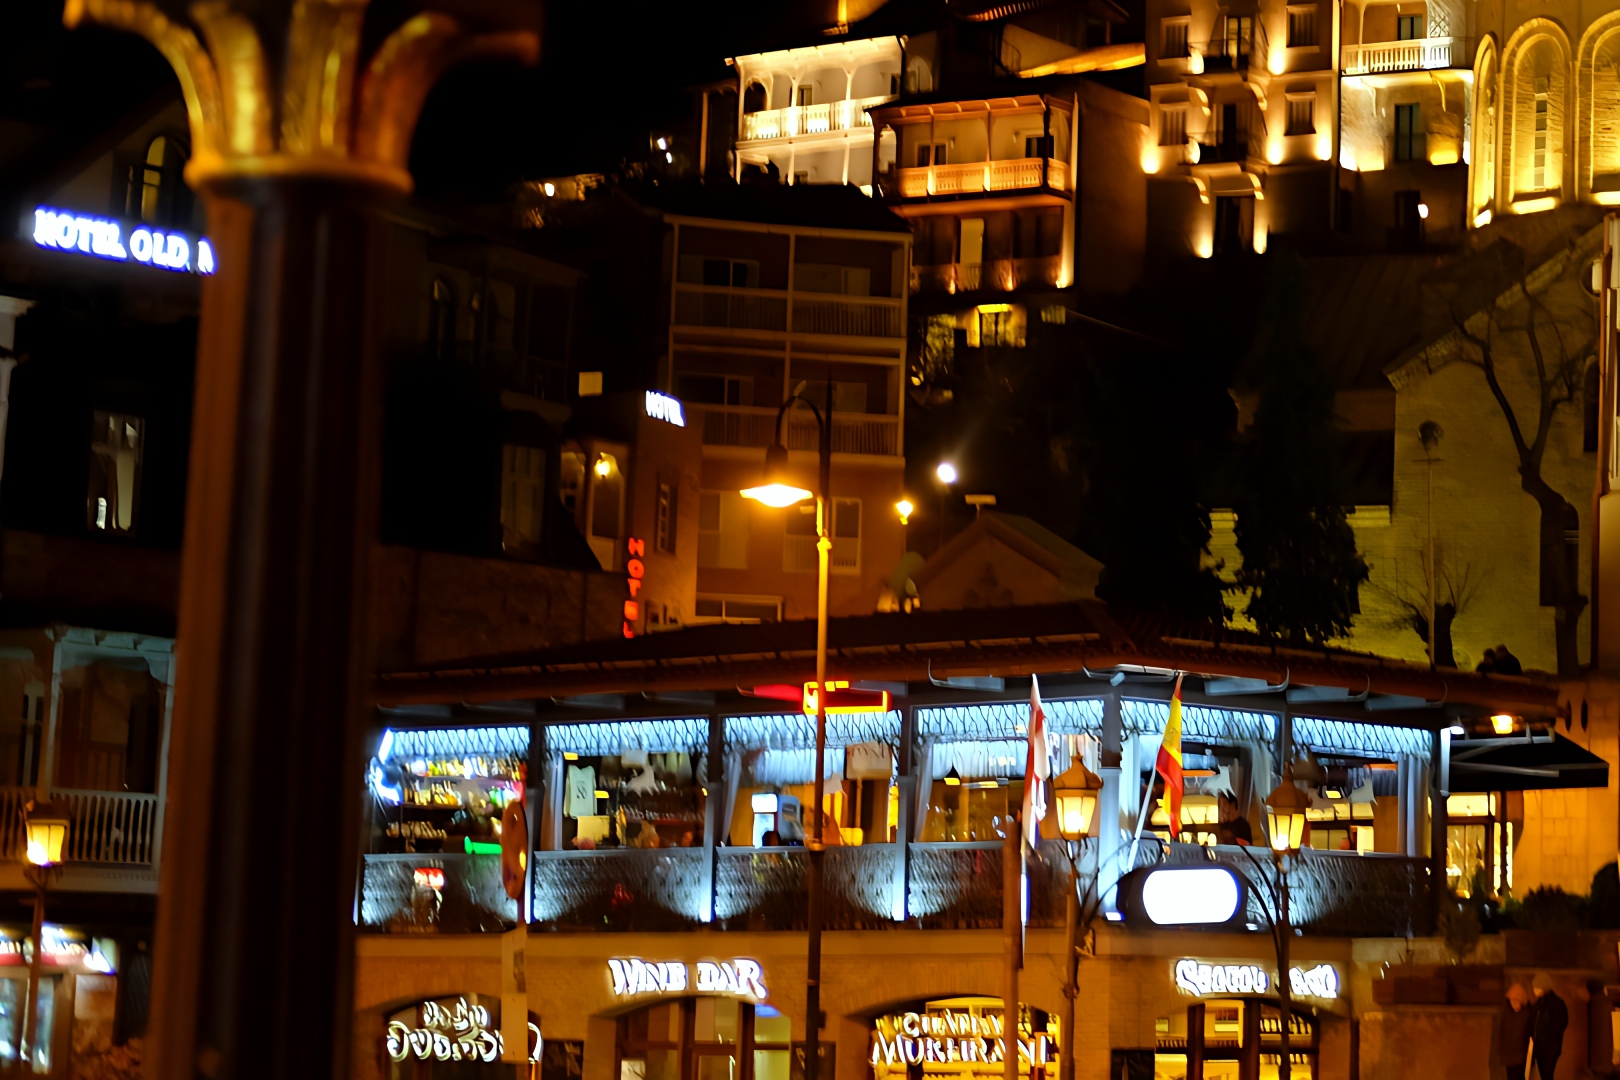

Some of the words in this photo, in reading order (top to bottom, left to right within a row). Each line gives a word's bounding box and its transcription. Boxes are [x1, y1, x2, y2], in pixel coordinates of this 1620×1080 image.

[33, 208, 128, 260] HOTEL
[129, 228, 190, 270] OLD
[623, 536, 645, 640] HOTEL
